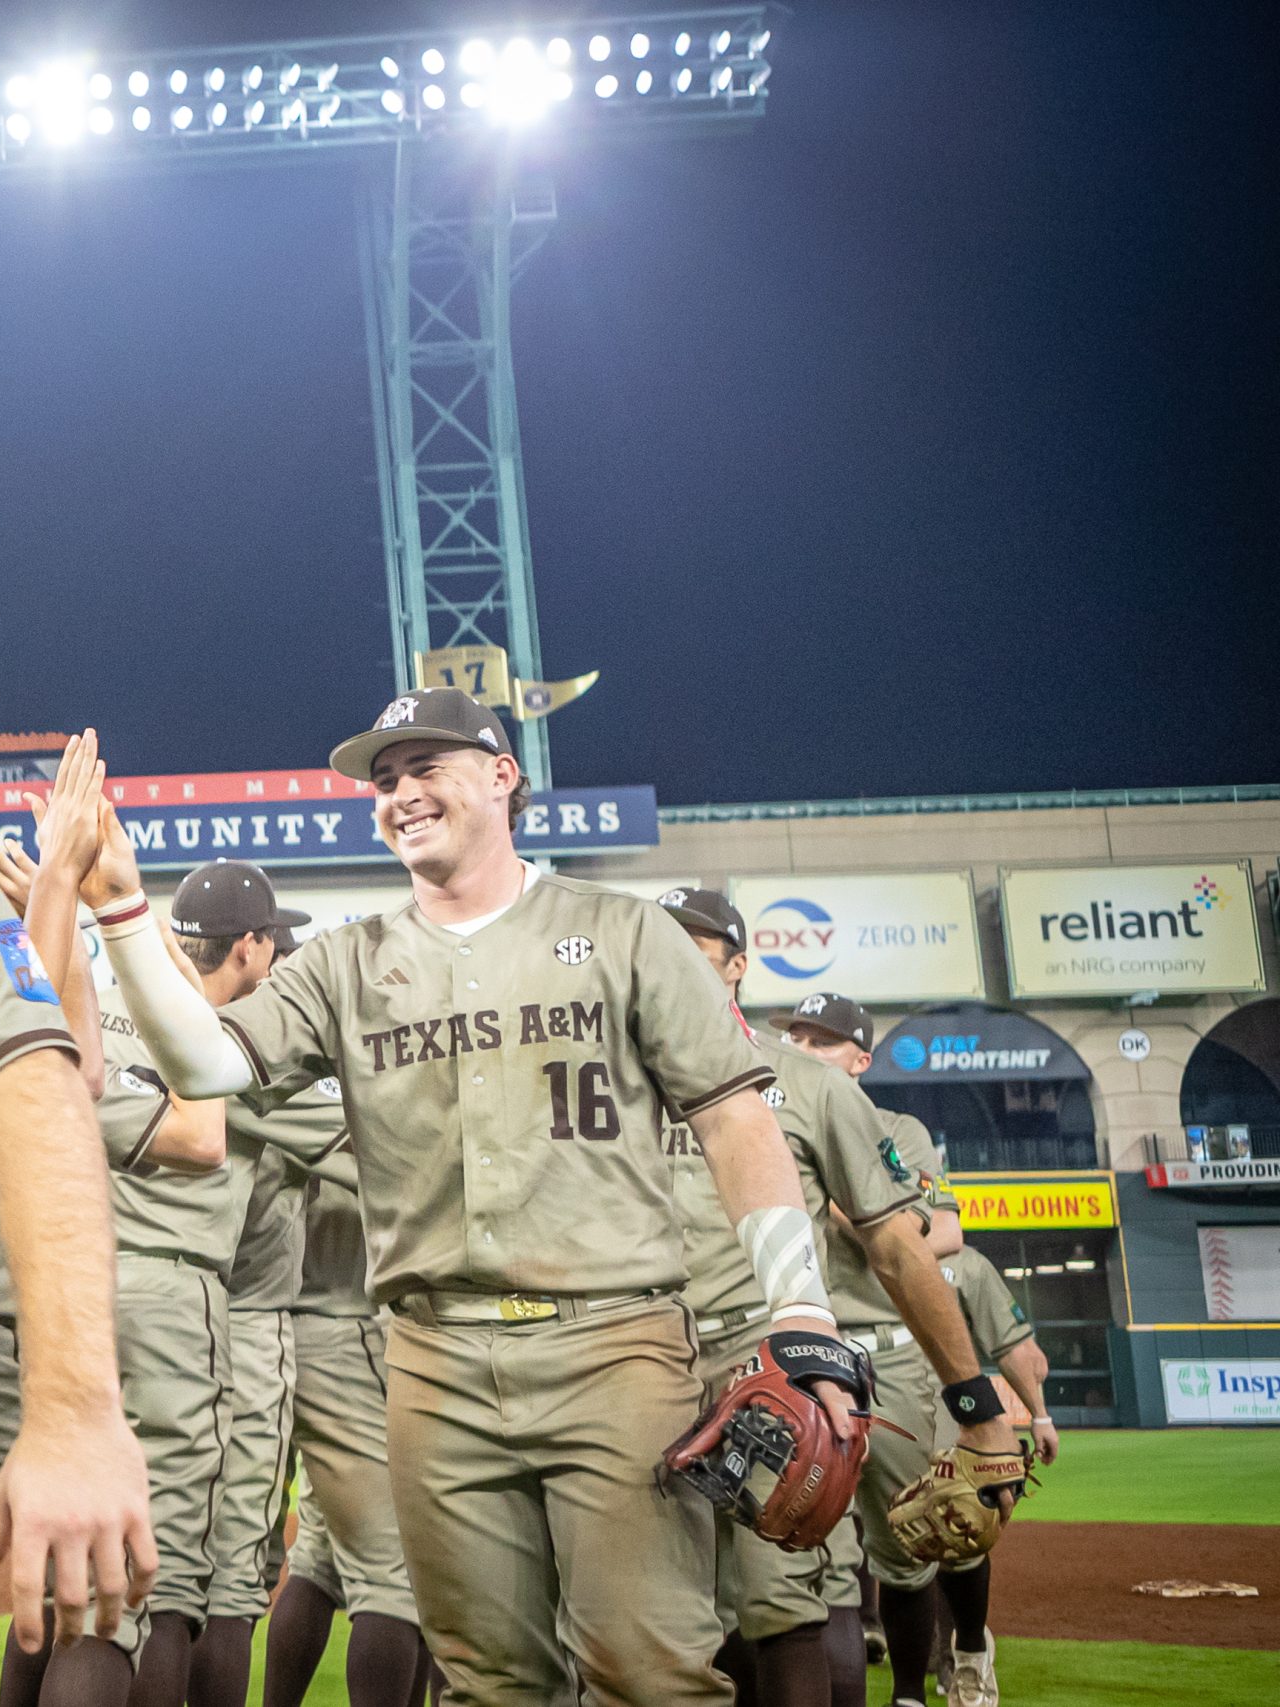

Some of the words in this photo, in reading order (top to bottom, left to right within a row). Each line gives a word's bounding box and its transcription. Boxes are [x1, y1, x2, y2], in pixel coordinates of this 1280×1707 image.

[440, 661, 486, 696] 17
[1040, 900, 1204, 942] reliant
[753, 928, 835, 949] OXY
[857, 924, 916, 947] ZERO
[555, 937, 593, 964] SEC
[1046, 960, 1067, 976] an
[1071, 957, 1115, 975] NRG
[1119, 958, 1206, 976] company
[363, 1009, 502, 1072] TEXAS
[520, 1001, 604, 1046] A&M
[930, 1035, 980, 1051] AT&T
[930, 1049, 1051, 1071] SPORTSNET
[542, 1060, 621, 1141] 16
[1018, 1194, 1101, 1217] JOHN'S
[786, 1345, 852, 1372] Wilson
[974, 1462, 1020, 1473] Wilson
